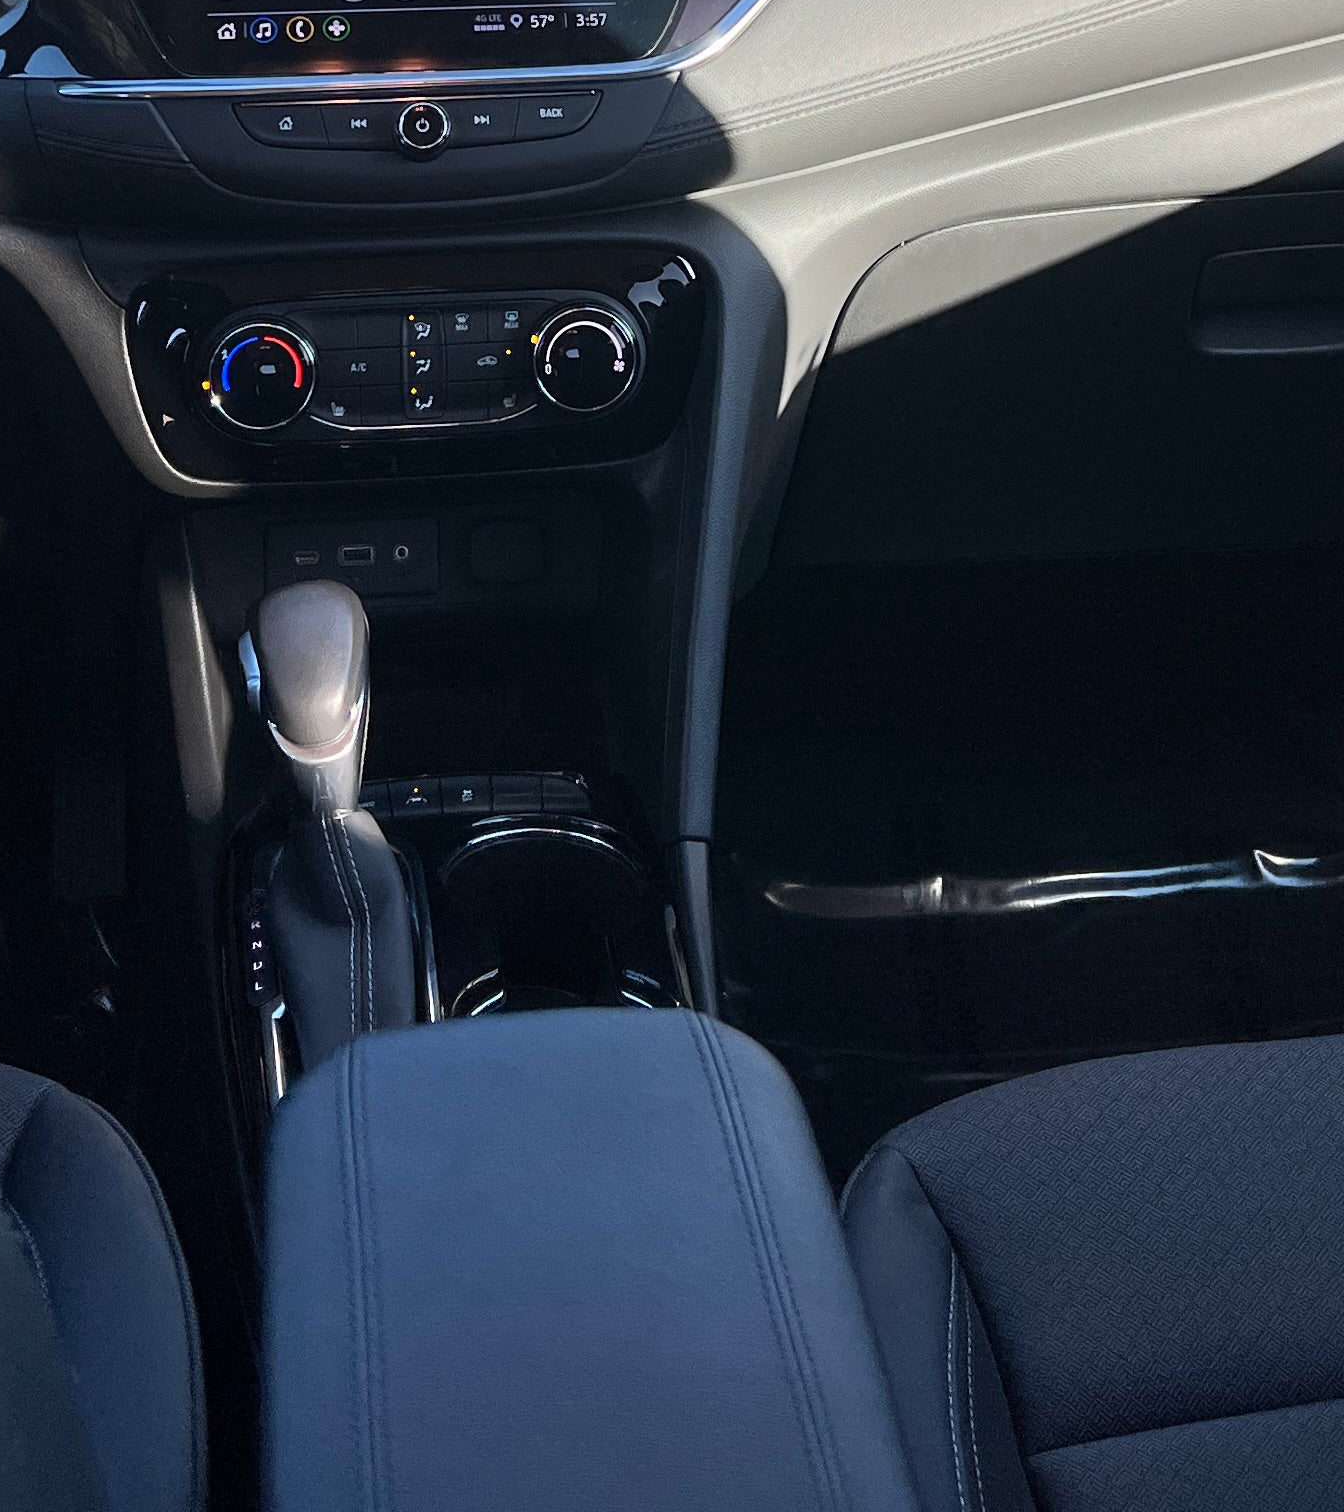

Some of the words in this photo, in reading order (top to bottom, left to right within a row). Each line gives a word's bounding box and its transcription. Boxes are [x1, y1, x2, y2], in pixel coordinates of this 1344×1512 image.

[475, 13, 487, 22] 4G
[488, 13, 502, 23] LTE
[575, 12, 607, 27] 3:57
[539, 107, 563, 118] BACK
[350, 362, 367, 373] A/C
[252, 940, 262, 949] N
[255, 981, 263, 990] L
